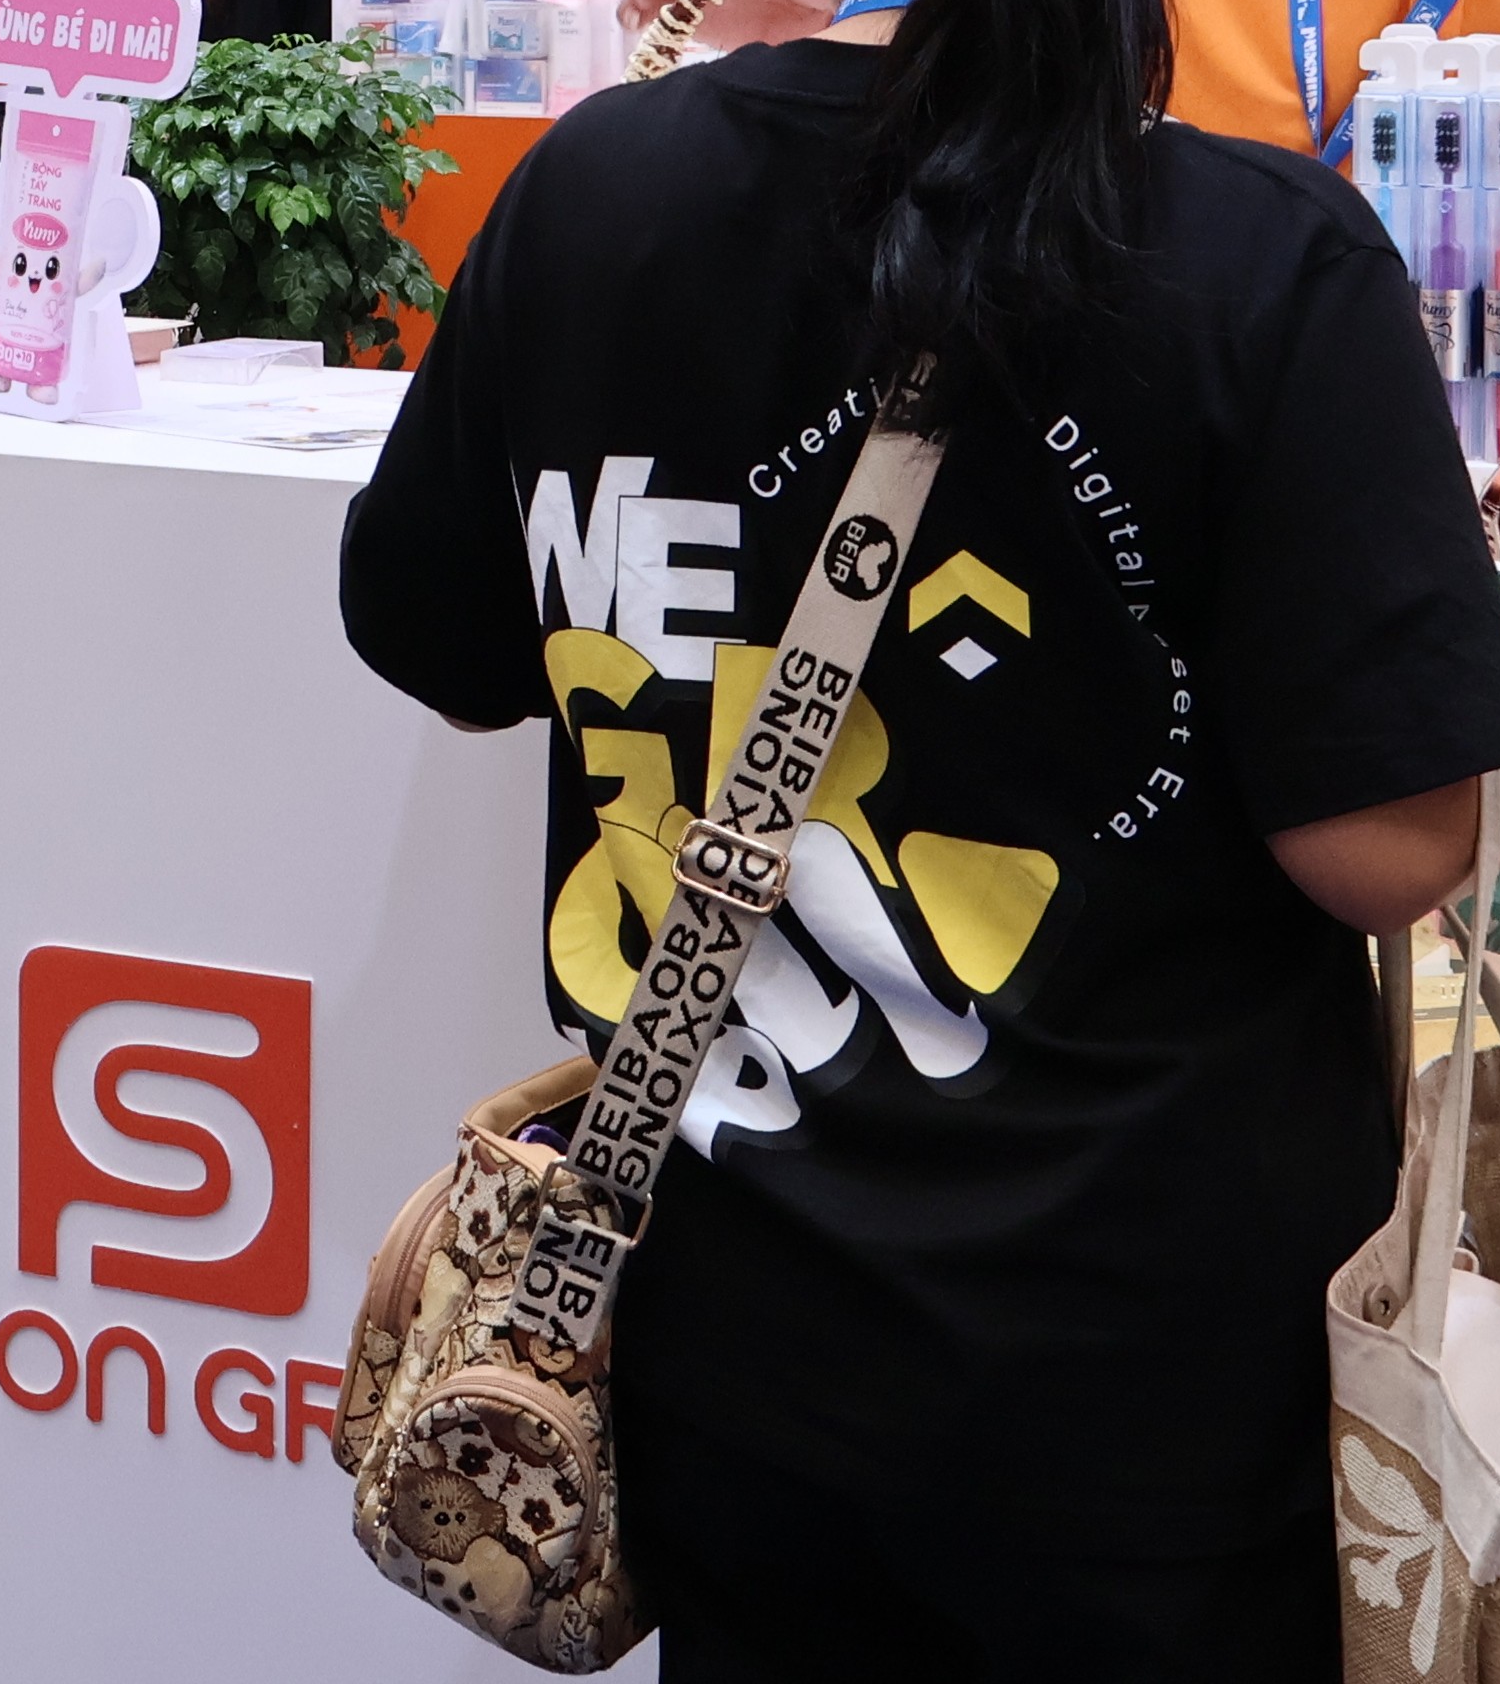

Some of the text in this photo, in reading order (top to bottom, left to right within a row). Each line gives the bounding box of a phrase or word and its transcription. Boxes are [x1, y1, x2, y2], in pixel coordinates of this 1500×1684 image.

[52, 8, 85, 51] BÉ
[89, 18, 118, 55] ĐI
[122, 16, 174, 62] MÀ!
[21, 216, 61, 248] Yumy
[1091, 765, 1186, 841] Era.
